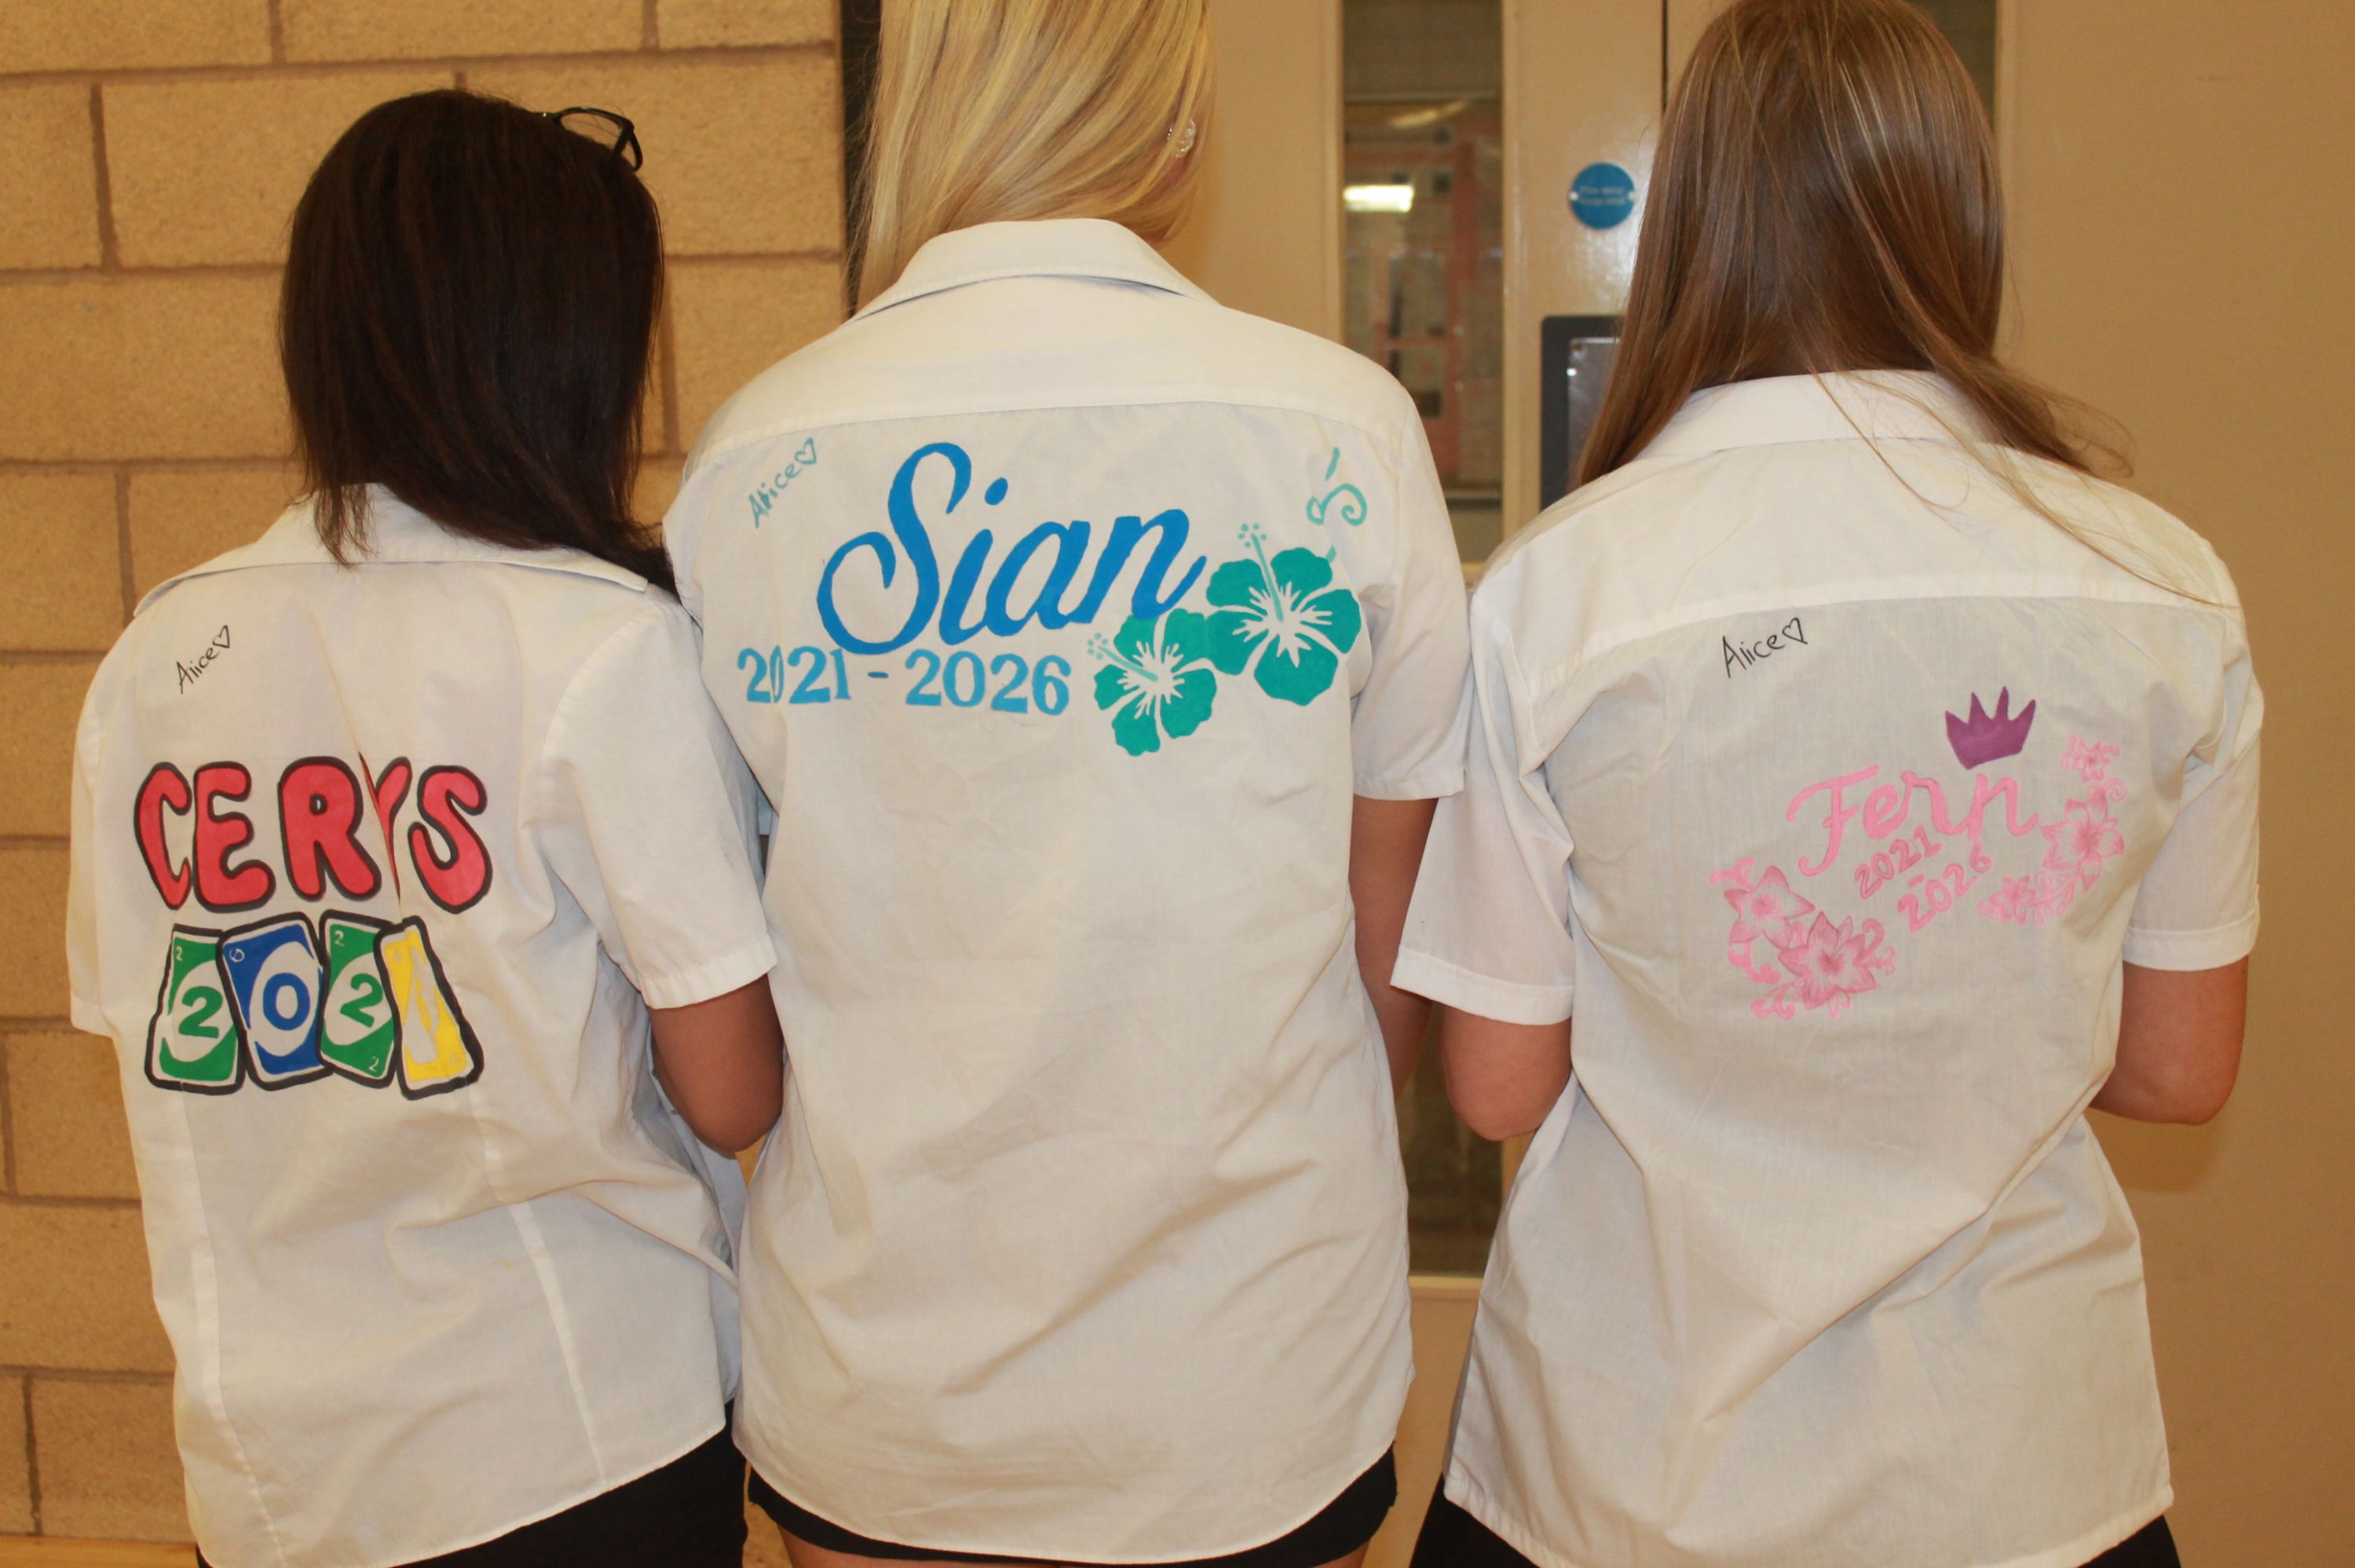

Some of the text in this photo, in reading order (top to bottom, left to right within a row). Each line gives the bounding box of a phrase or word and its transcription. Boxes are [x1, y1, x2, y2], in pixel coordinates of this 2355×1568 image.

[748, 463, 802, 528] Alice
[816, 442, 1207, 655] Sian
[176, 647, 220, 694] Alice
[737, 645, 852, 704] 2021
[905, 649, 1071, 715] 2026
[1722, 634, 1786, 678] Alice
[1786, 764, 2039, 876] Fern
[1855, 825, 1944, 899] 2021
[1897, 842, 1993, 933] 2026
[178, 970, 436, 1040] 202
